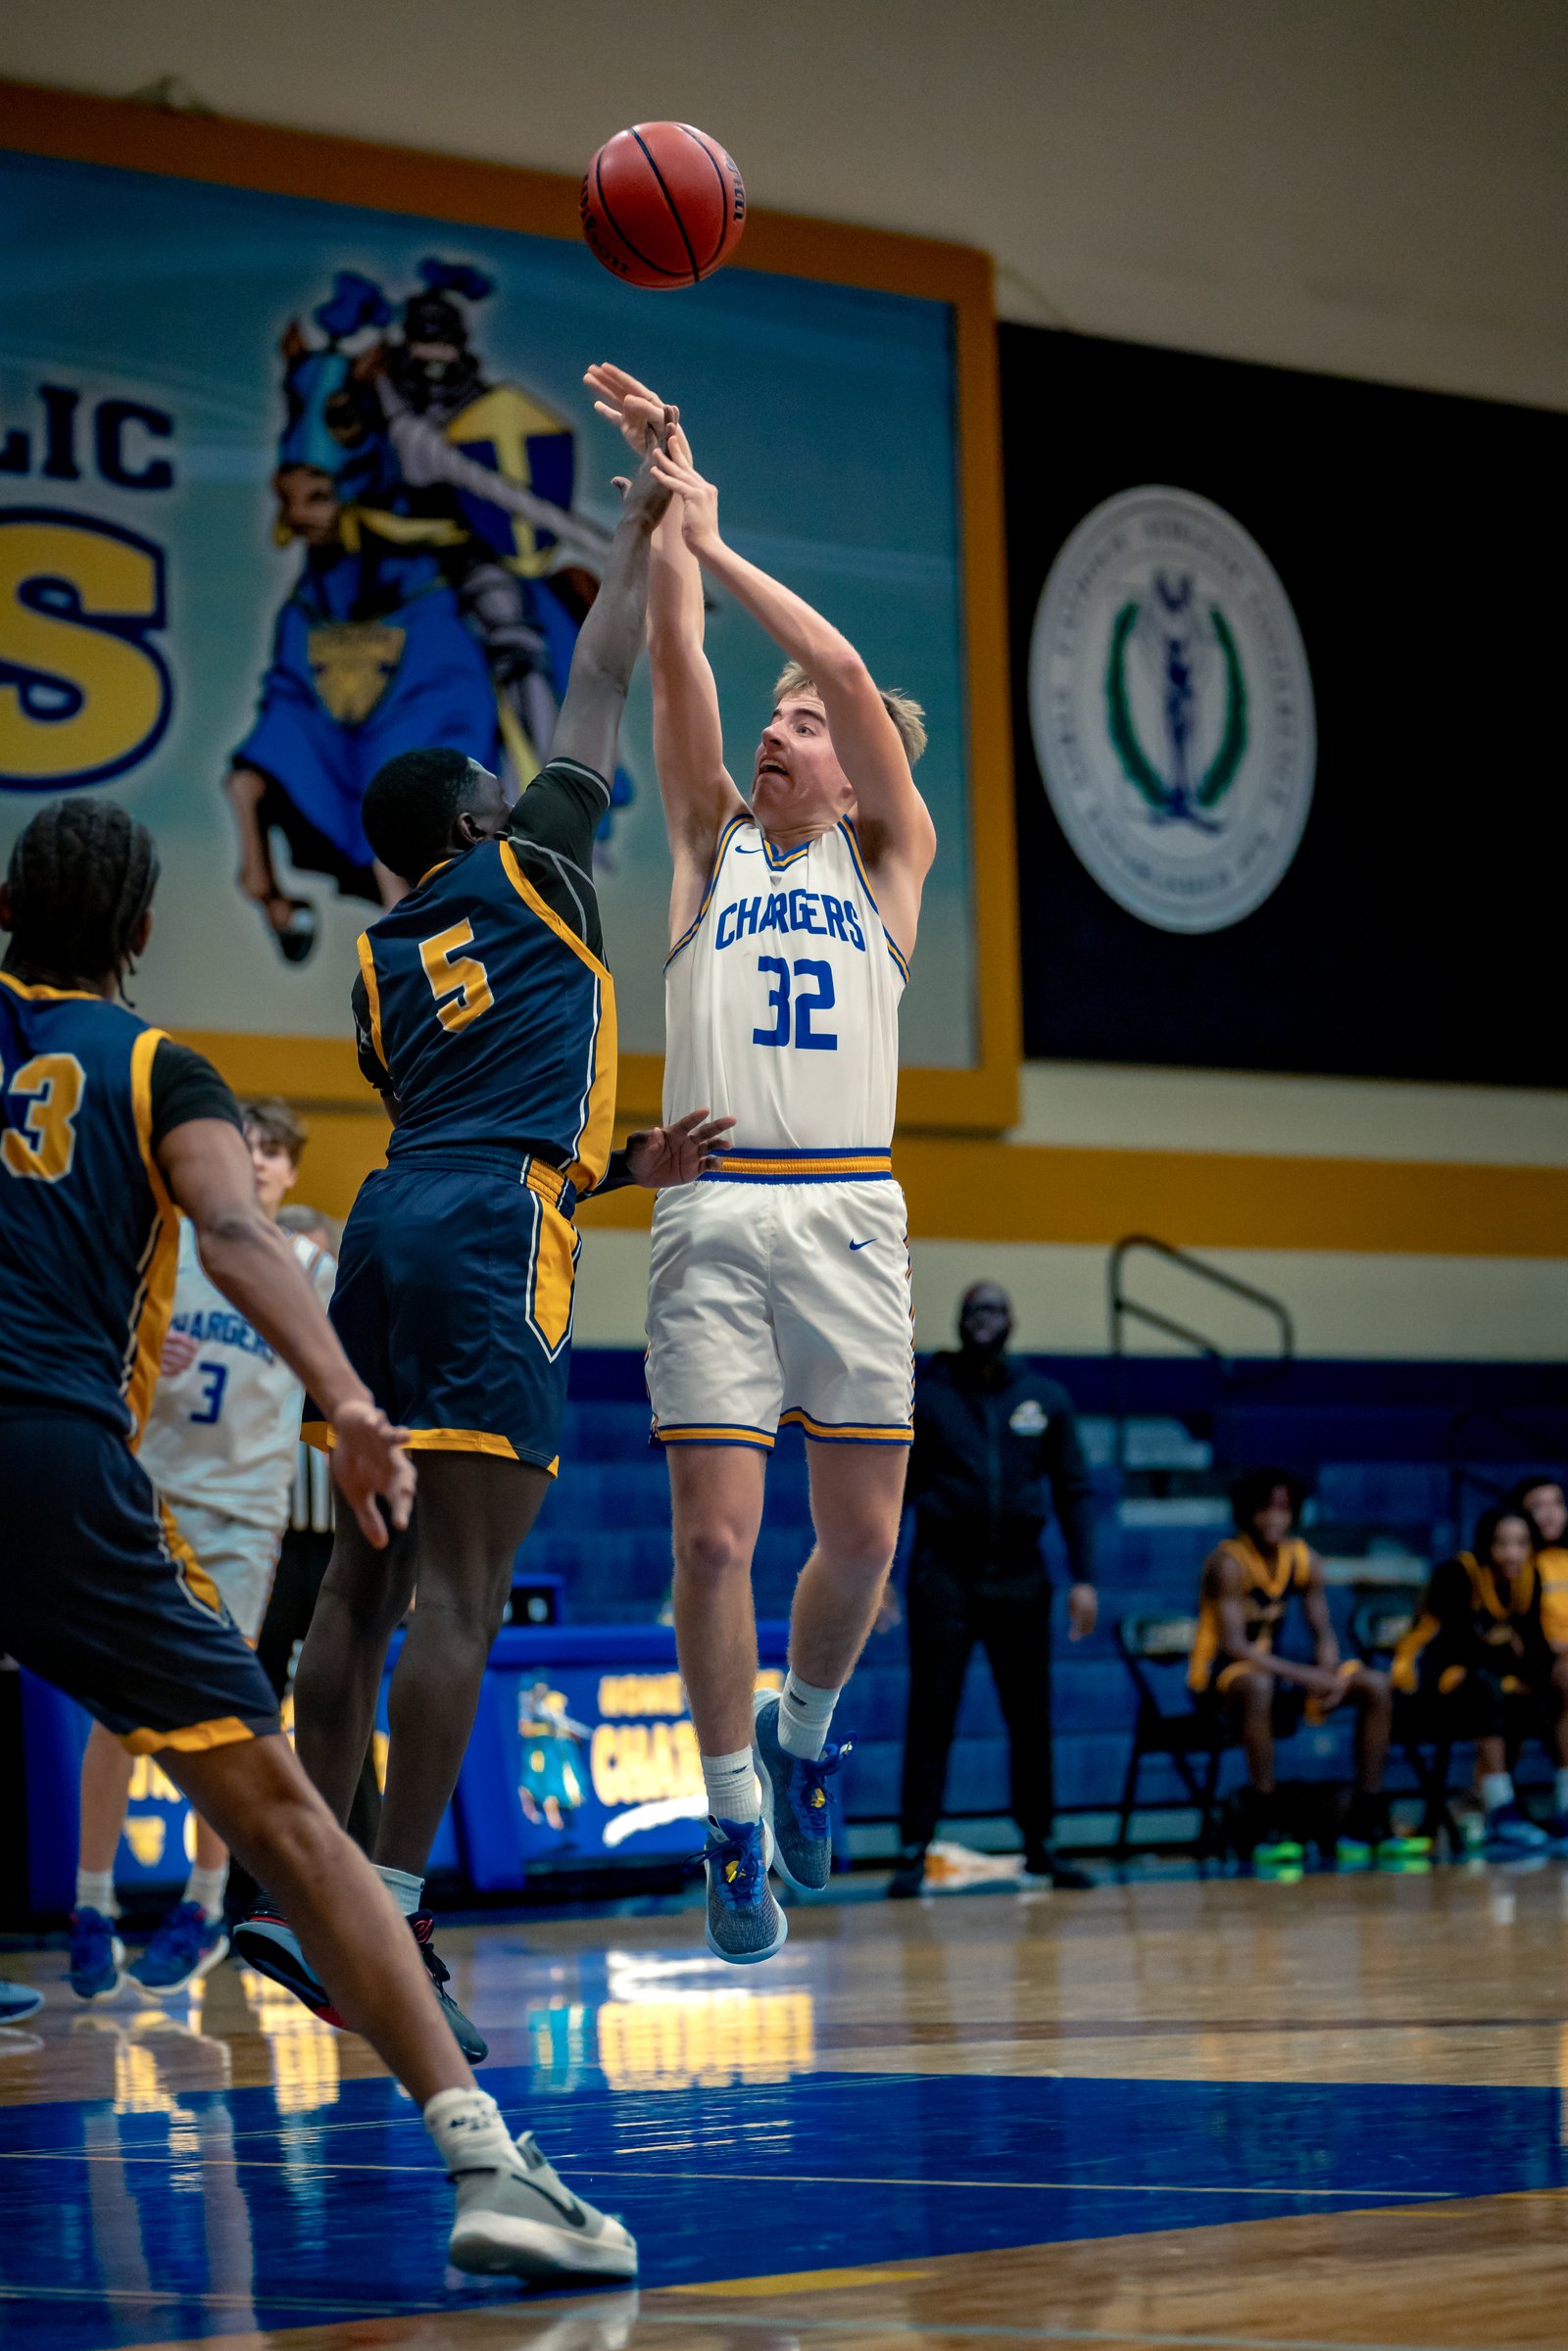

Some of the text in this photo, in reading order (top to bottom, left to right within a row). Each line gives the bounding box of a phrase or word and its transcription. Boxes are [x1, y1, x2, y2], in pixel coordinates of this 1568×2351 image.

[715, 889, 866, 953] CHARGERS
[418, 917, 495, 1034] 5
[753, 955, 838, 1052] 32
[0, 1052, 87, 1185] 3
[190, 1361, 229, 1424] 3
